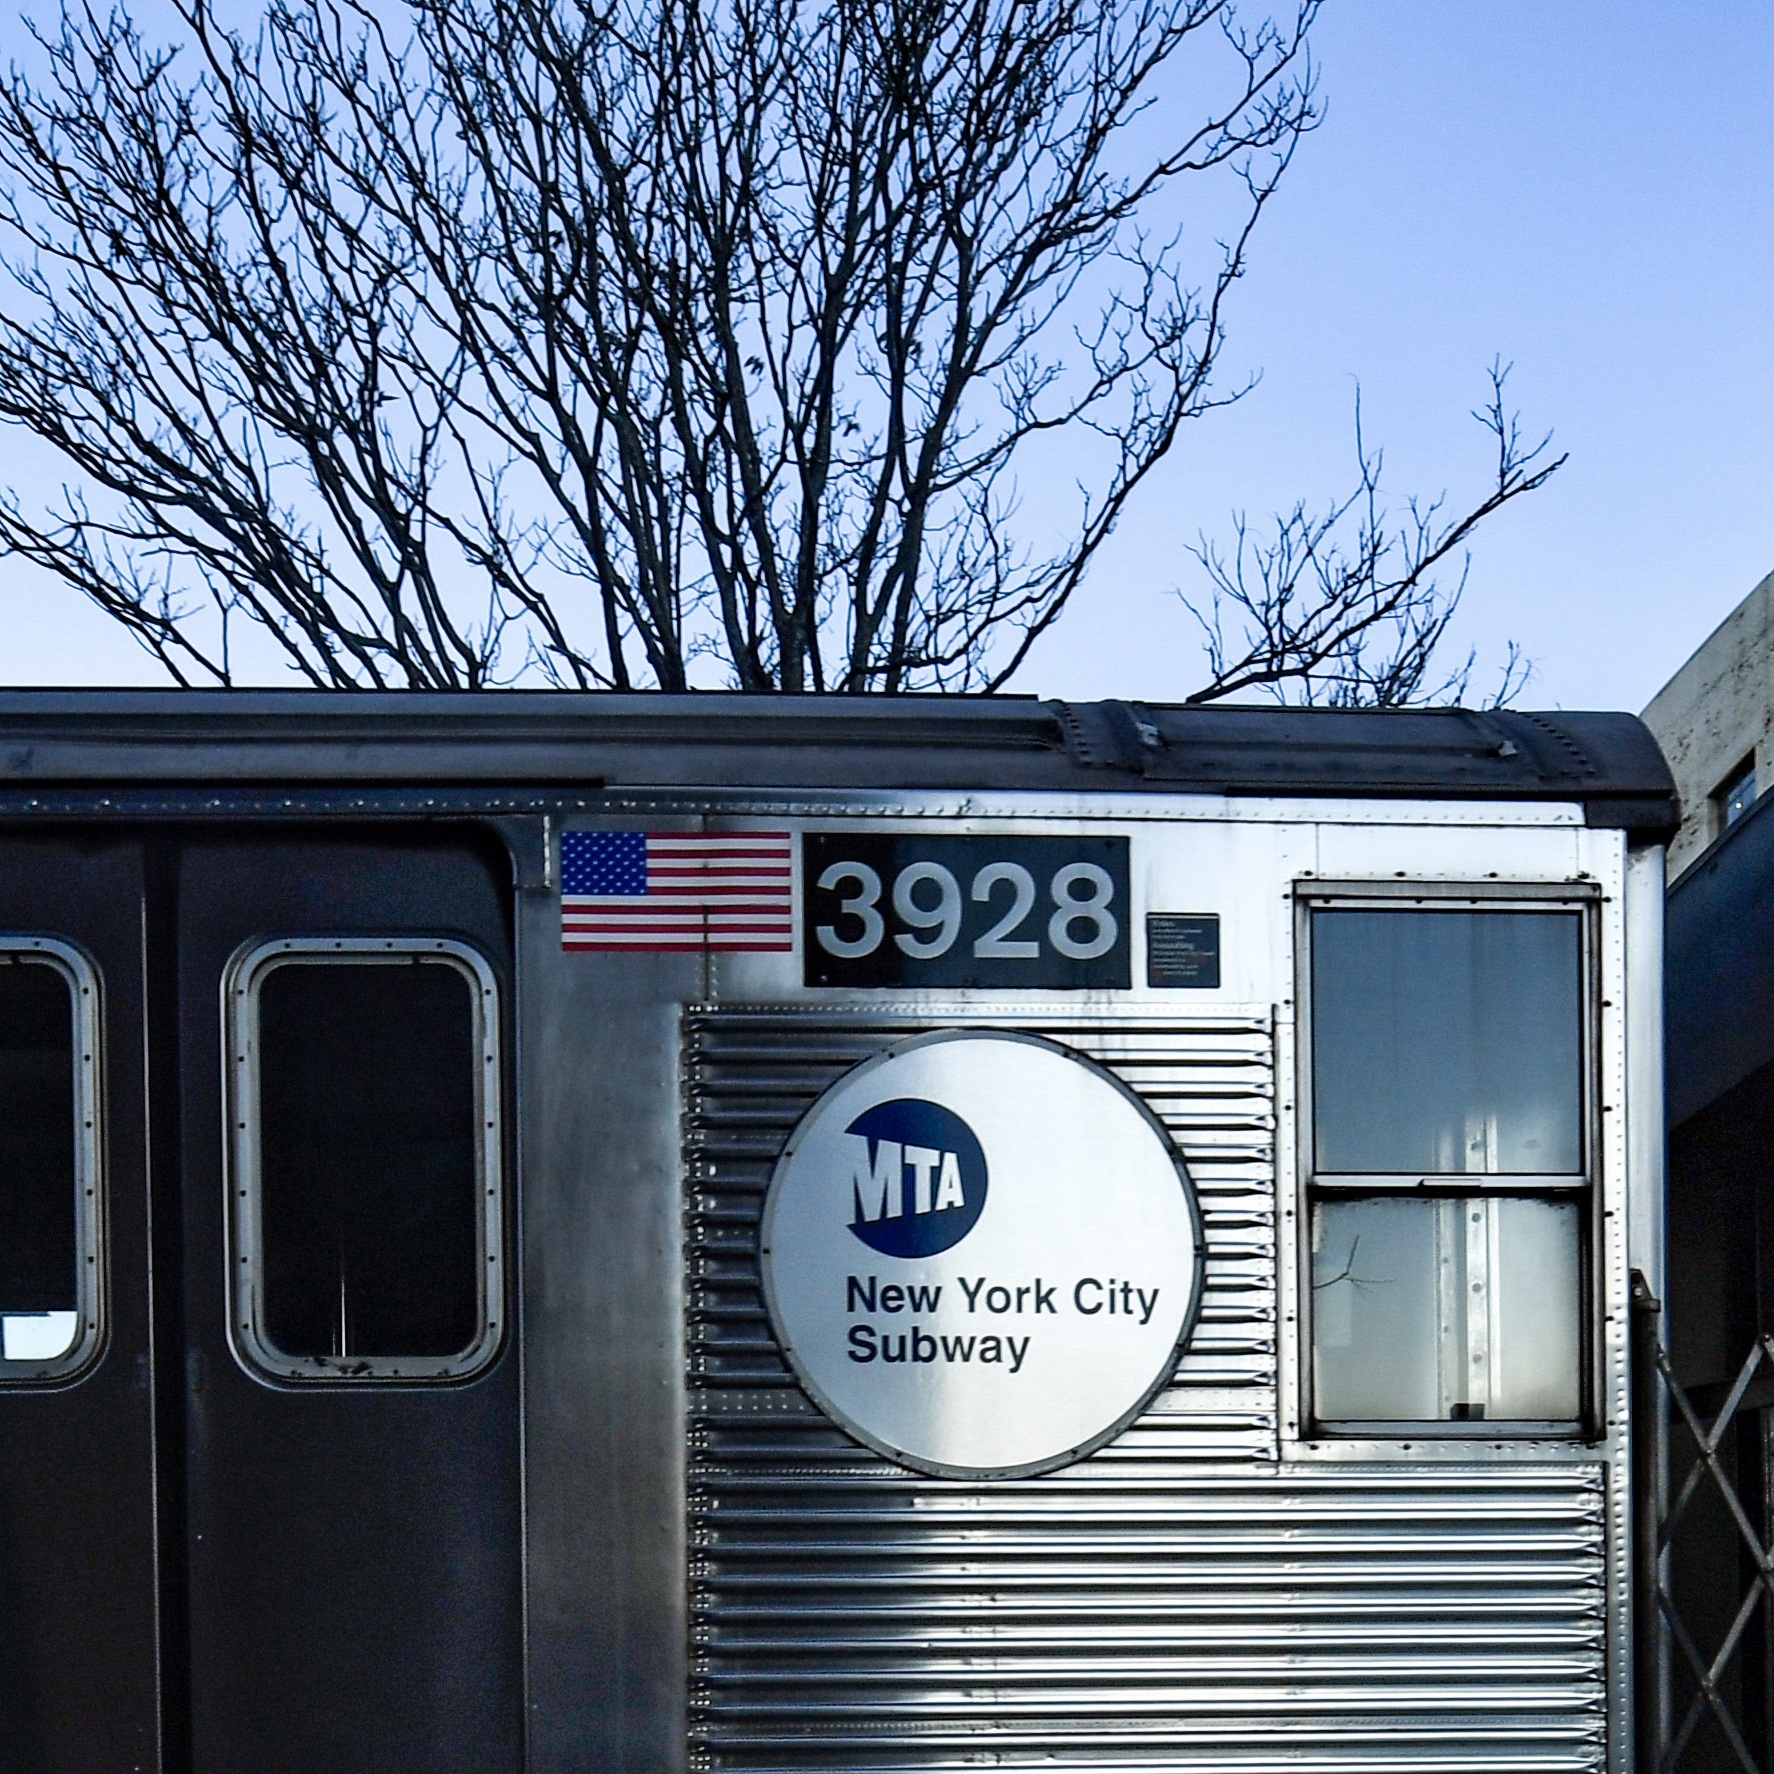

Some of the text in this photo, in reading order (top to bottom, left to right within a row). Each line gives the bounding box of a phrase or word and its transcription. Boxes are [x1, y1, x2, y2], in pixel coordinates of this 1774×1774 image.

[815, 860, 1120, 960] 3928
[845, 1131, 966, 1225] MTA
[846, 1275, 1161, 1326] New York City
[847, 1325, 1031, 1374] Subway
